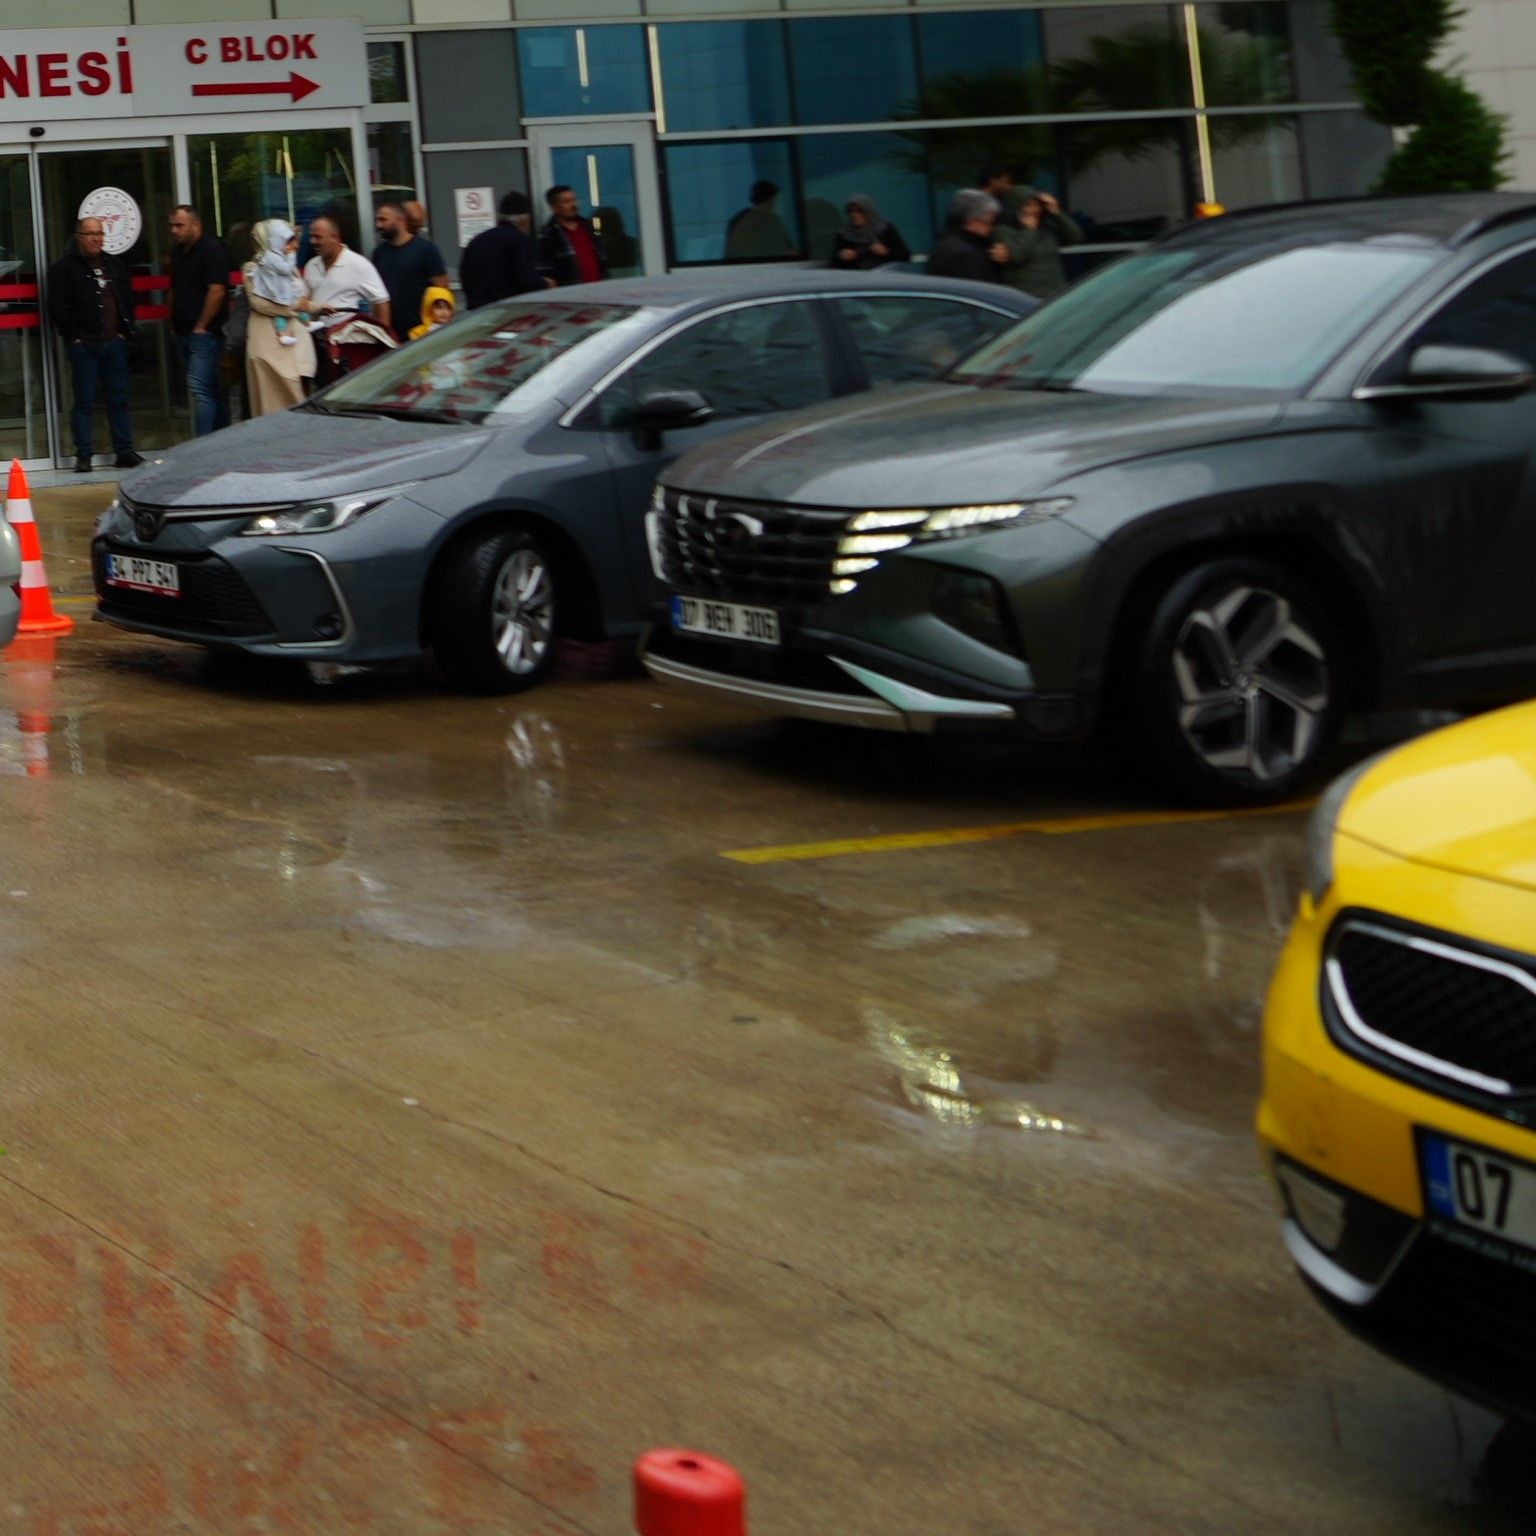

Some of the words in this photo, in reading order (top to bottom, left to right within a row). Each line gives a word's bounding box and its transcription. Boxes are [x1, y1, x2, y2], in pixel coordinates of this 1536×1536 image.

[185, 38, 208, 65] C
[220, 32, 318, 64] BLOK
[1455, 1151, 1513, 1230] 07
